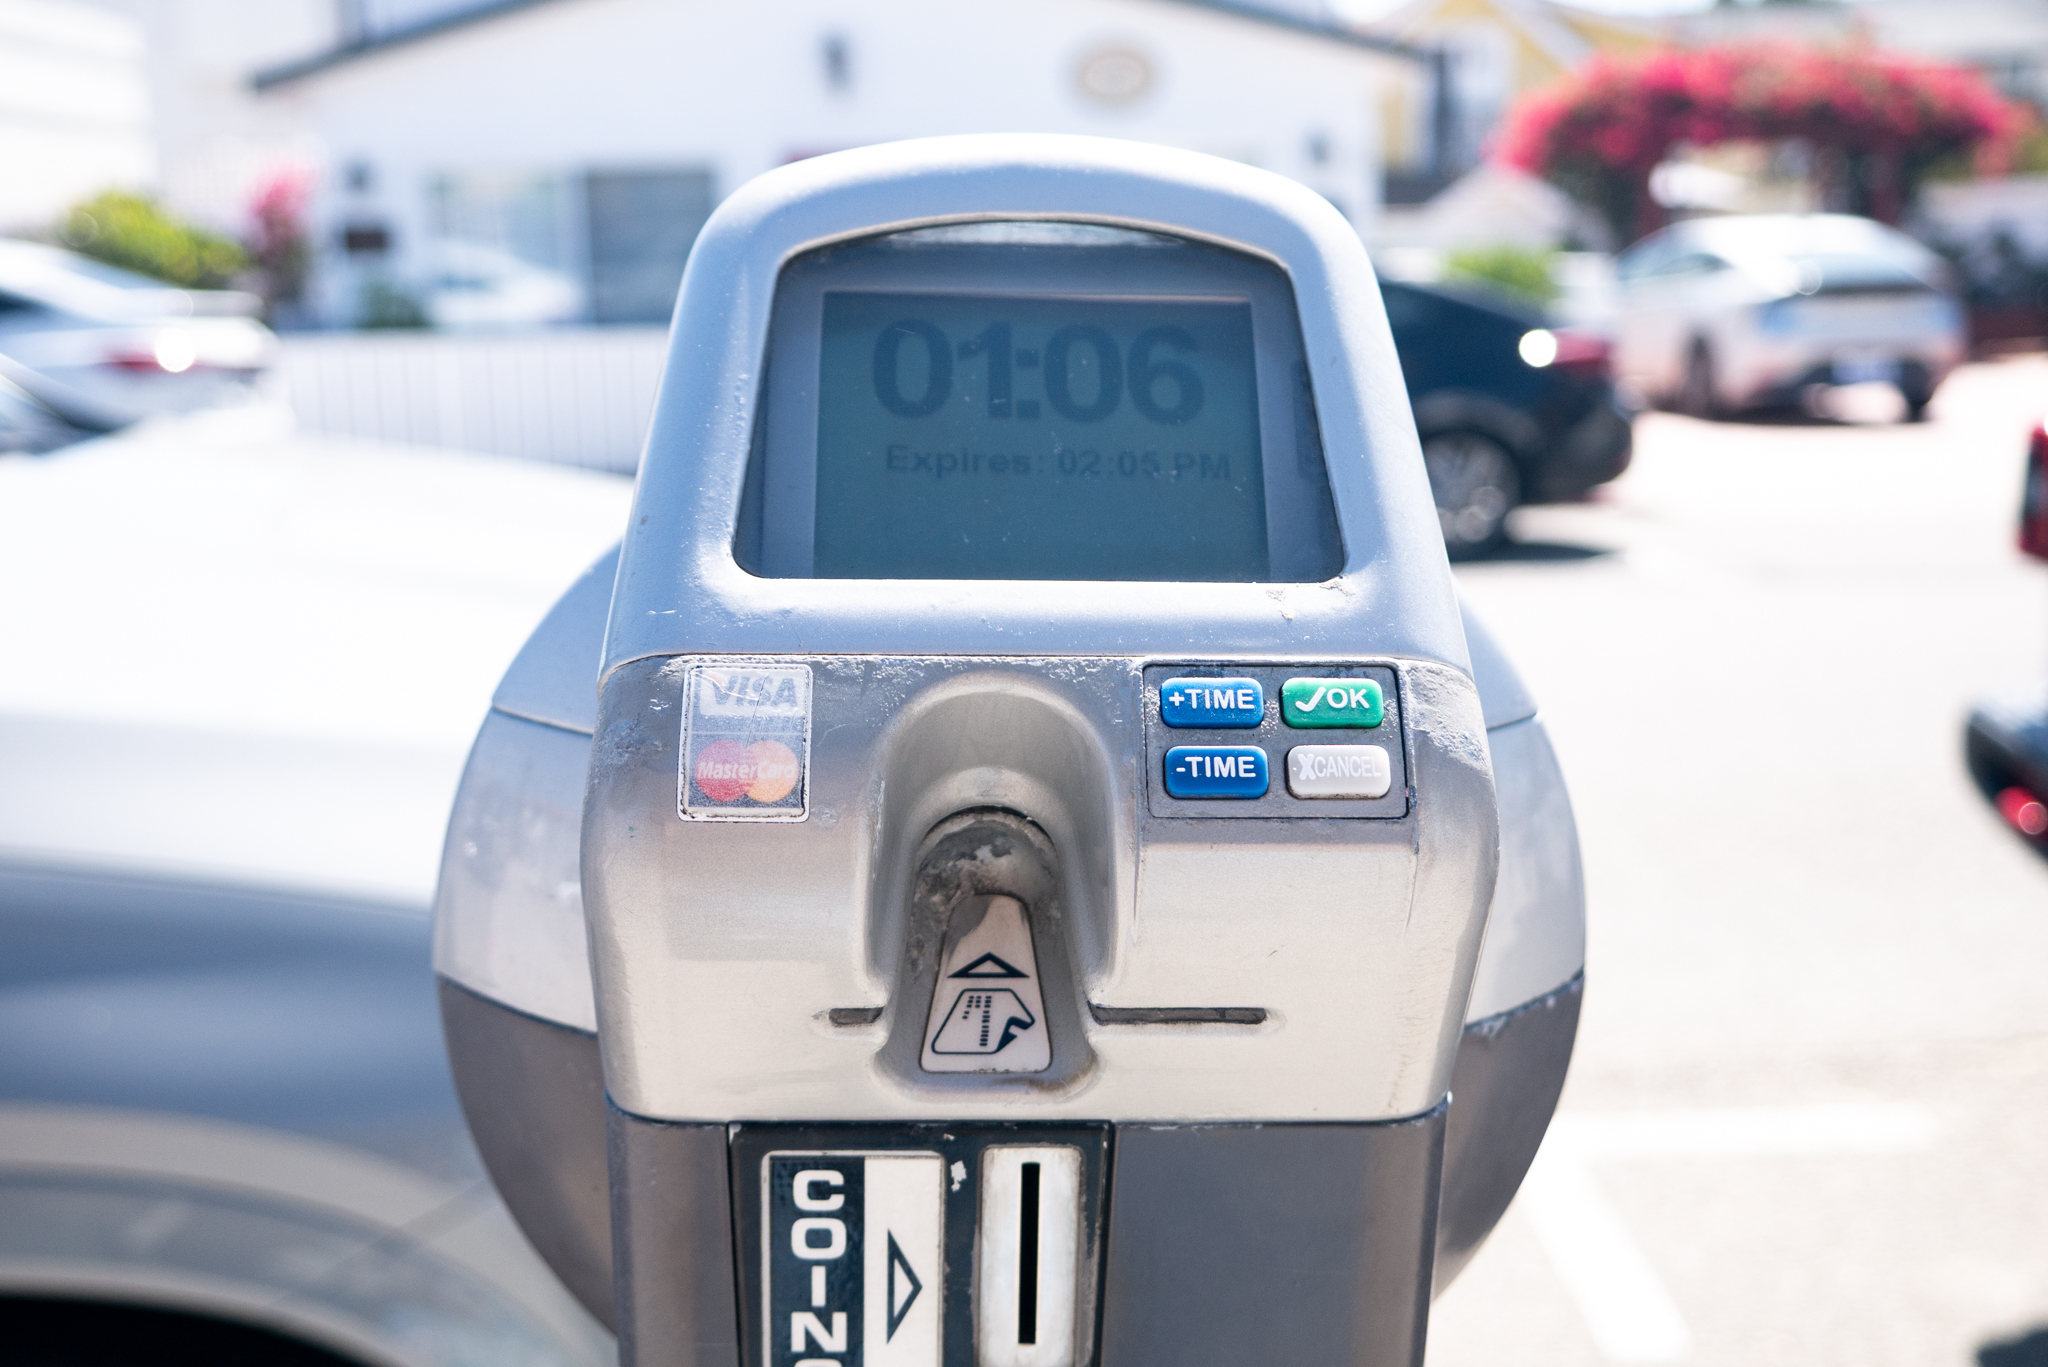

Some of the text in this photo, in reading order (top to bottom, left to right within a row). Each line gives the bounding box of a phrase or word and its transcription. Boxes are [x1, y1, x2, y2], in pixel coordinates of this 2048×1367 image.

[871, 318, 1206, 425] 01:06
[885, 444, 1231, 481] Expires: 02:05 PM
[711, 675, 798, 707] VISA
[1169, 689, 1255, 709] +TIME
[1327, 688, 1370, 709] OK
[697, 760, 797, 780] MasterCard
[1176, 756, 1256, 778] -TIME
[790, 1169, 848, 1367] COIN
